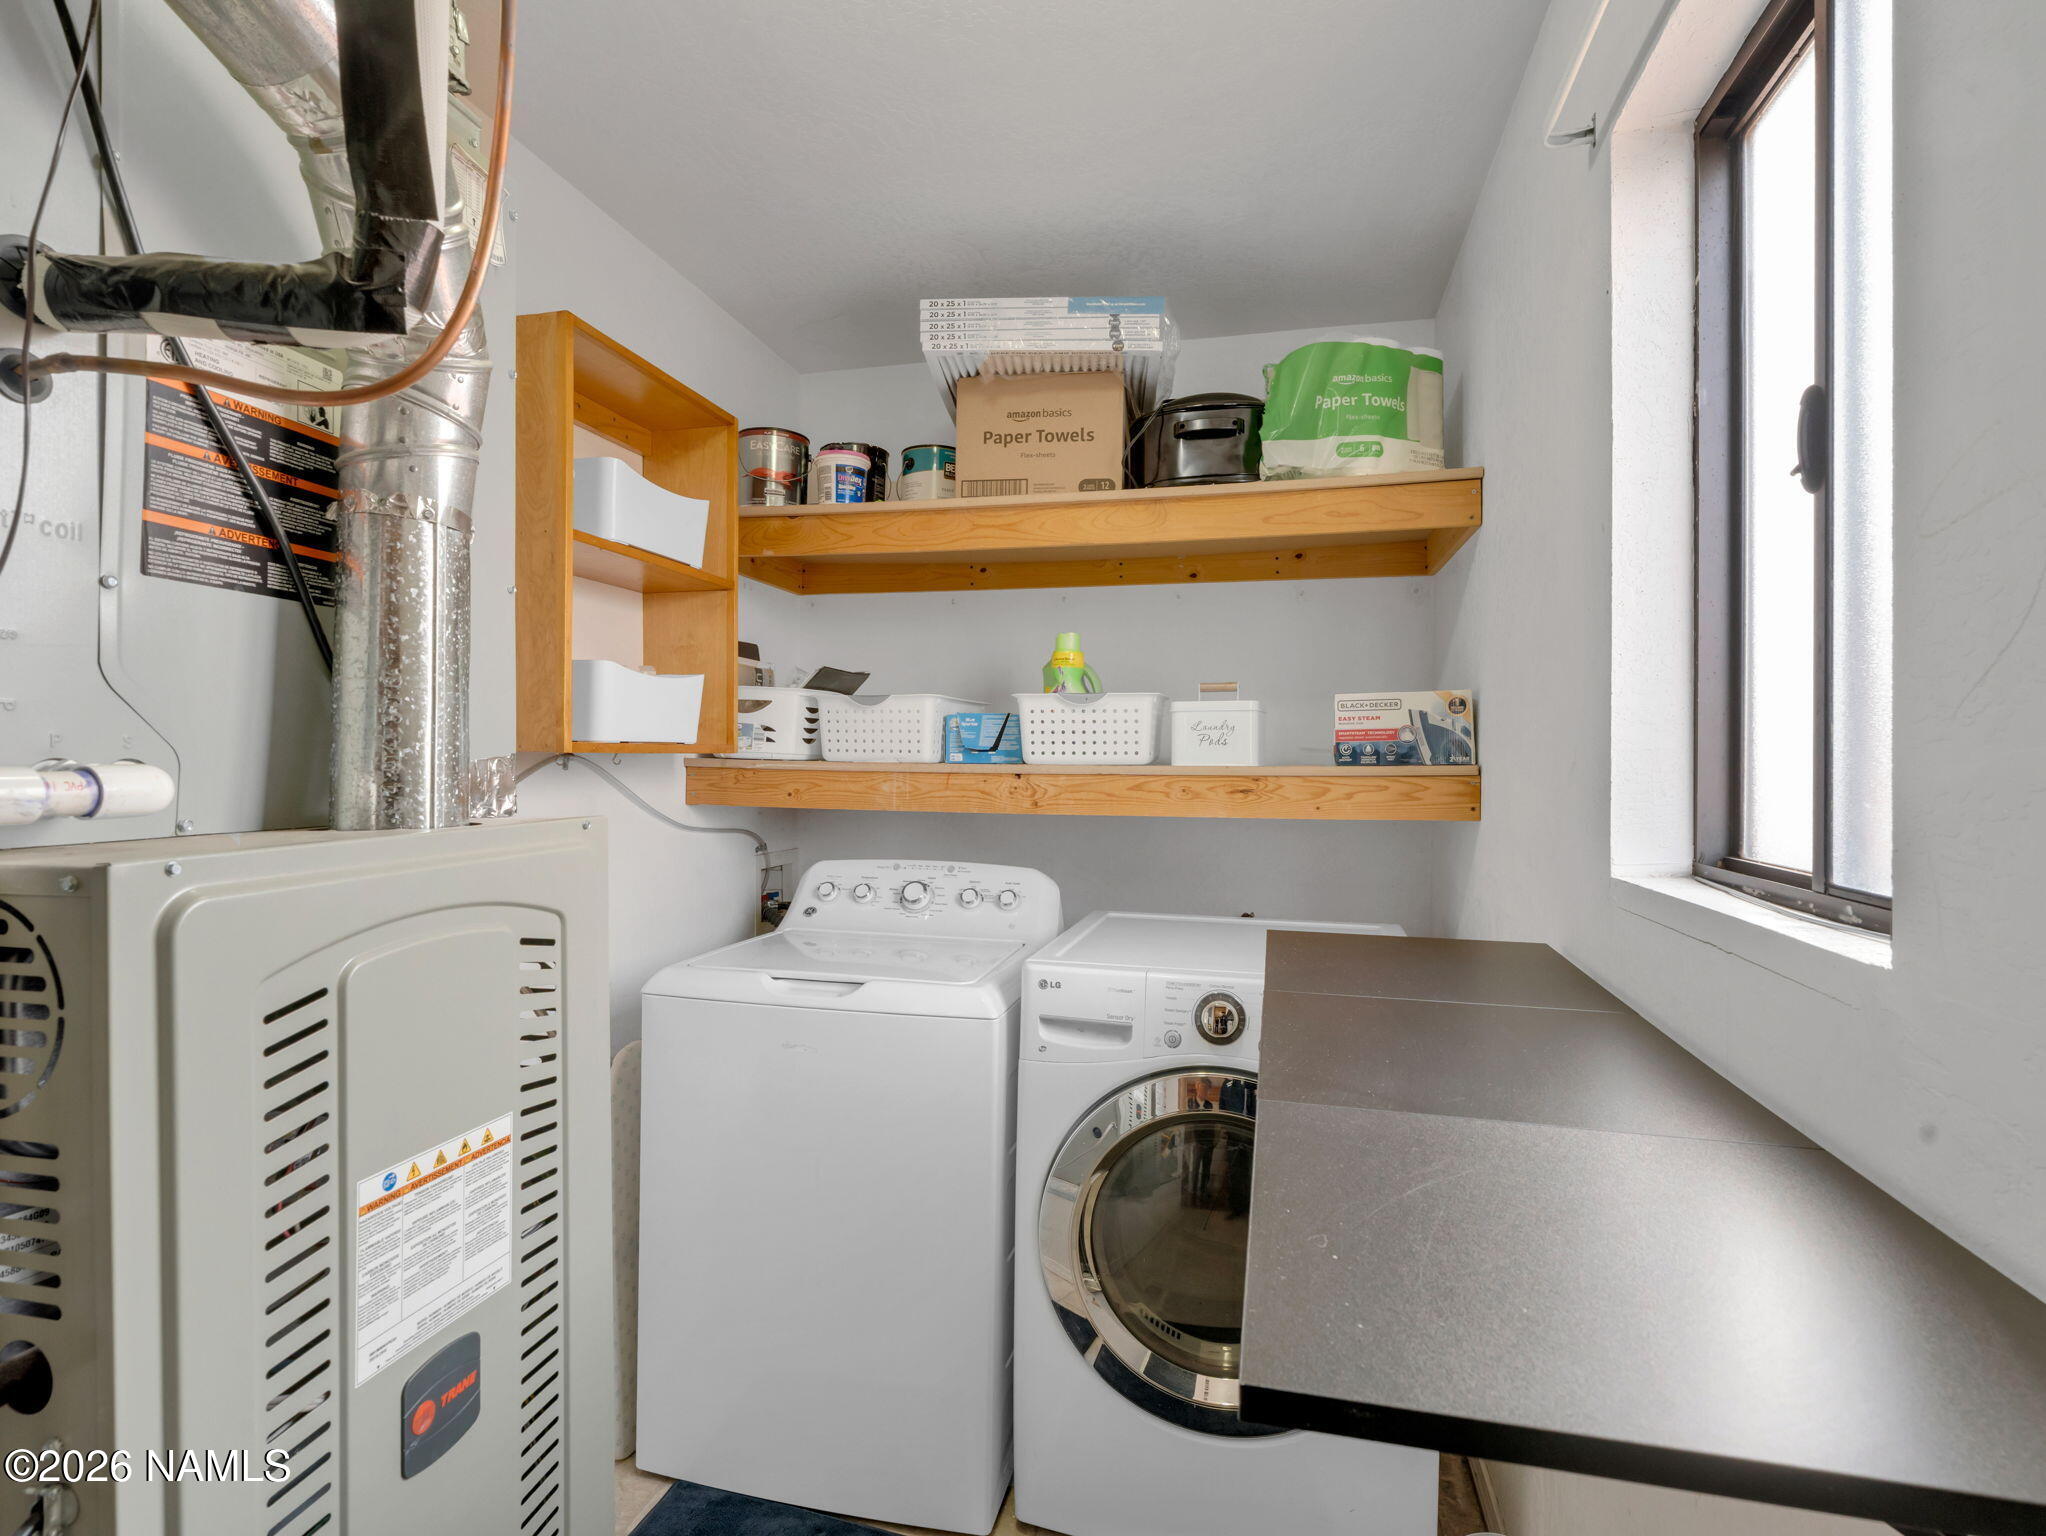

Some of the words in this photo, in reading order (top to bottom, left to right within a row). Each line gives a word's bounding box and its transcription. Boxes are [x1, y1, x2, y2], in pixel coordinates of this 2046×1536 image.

[194, 351, 220, 365] HEATING
[194, 357, 207, 367] AND
[1315, 394, 1358, 411] Paper
[1361, 392, 1406, 412] Towels
[233, 401, 282, 425] WARNING
[983, 431, 1032, 447] Paper
[1036, 427, 1094, 443] Towels
[1101, 481, 1110, 490] 12
[39, 519, 83, 541] coil
[1190, 719, 1235, 737] Laundry
[1197, 732, 1228, 747] Pods
[1050, 981, 1061, 989] LG
[1107, 1013, 1124, 1021] Sensor
[1125, 1015, 1134, 1023] Dry
[367, 1191, 401, 1212] WARNING
[441, 1369, 478, 1408] TRANE
